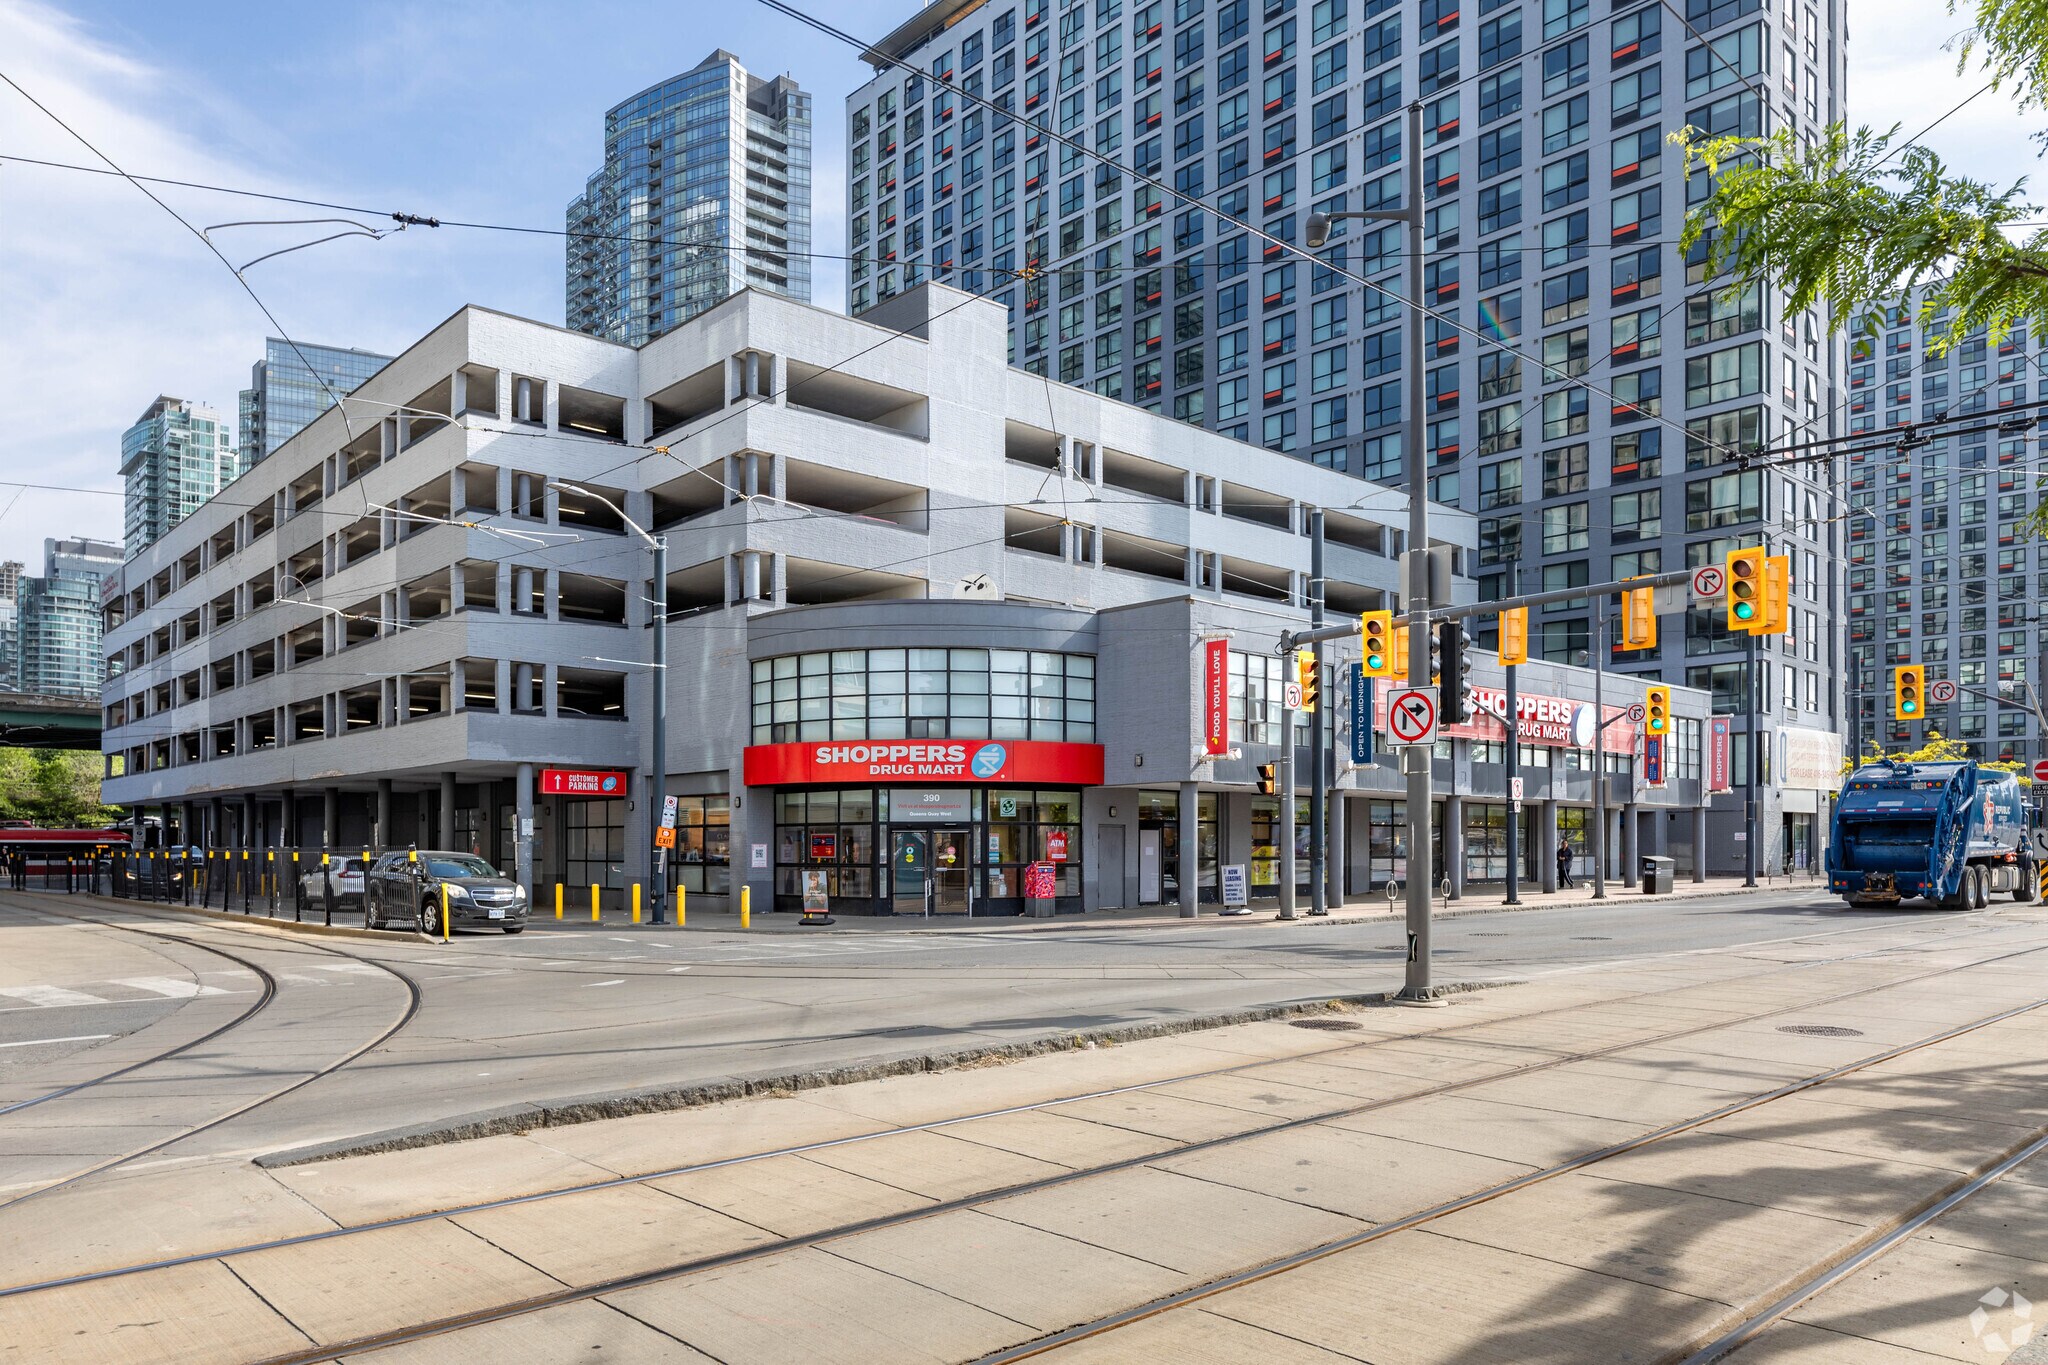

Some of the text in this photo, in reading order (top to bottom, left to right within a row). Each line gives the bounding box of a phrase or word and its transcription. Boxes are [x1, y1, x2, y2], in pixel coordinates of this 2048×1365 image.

[1357, 669, 1365, 757] OPEN TO MIDNIGHT
[1516, 722, 1573, 741] RUG MART
[815, 745, 967, 764] SHOPPERS
[869, 764, 966, 775] DRUG MART
[568, 774, 599, 783] CUSTOMER
[568, 782, 599, 791] PARKING
[923, 794, 940, 802] 390
[658, 837, 672, 846] EXIT
[1050, 839, 1065, 848] ATM
